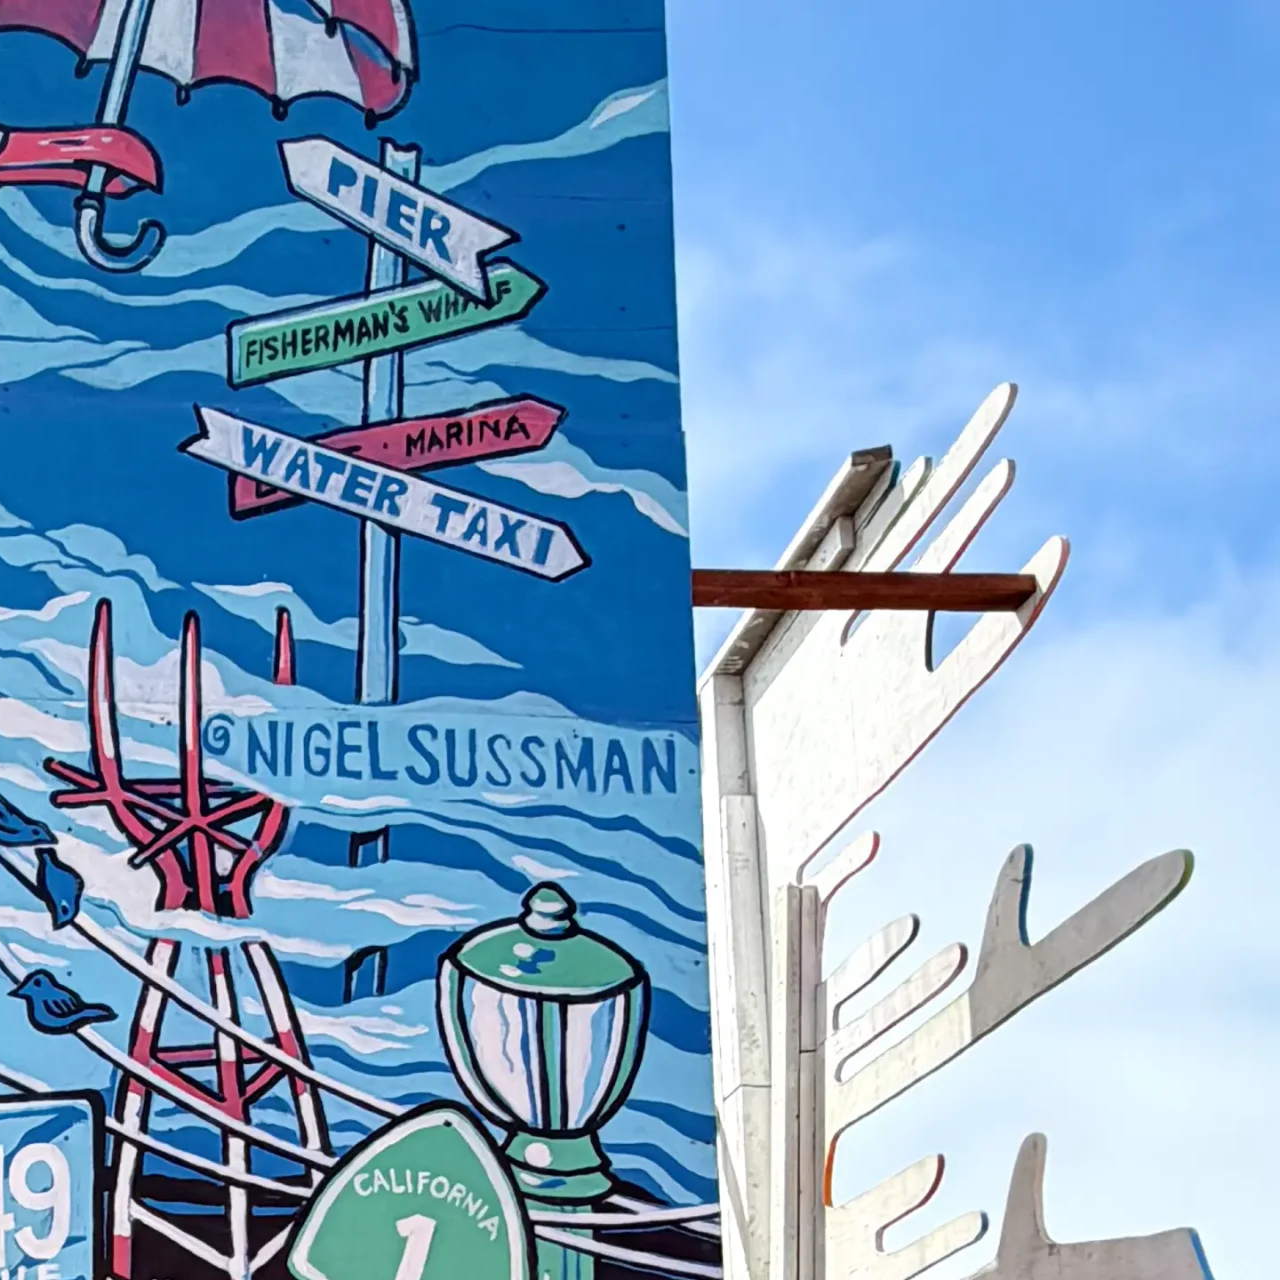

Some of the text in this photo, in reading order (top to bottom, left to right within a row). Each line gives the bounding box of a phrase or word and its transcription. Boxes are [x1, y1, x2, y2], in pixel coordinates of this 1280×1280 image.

[328, 157, 452, 263] PIER
[245, 279, 512, 368] FISHERMAN'S WHF
[405, 414, 531, 457] MARINA
[242, 426, 553, 567] WATER TAXI
[352, 1168, 501, 1241] CALIFORNIA
